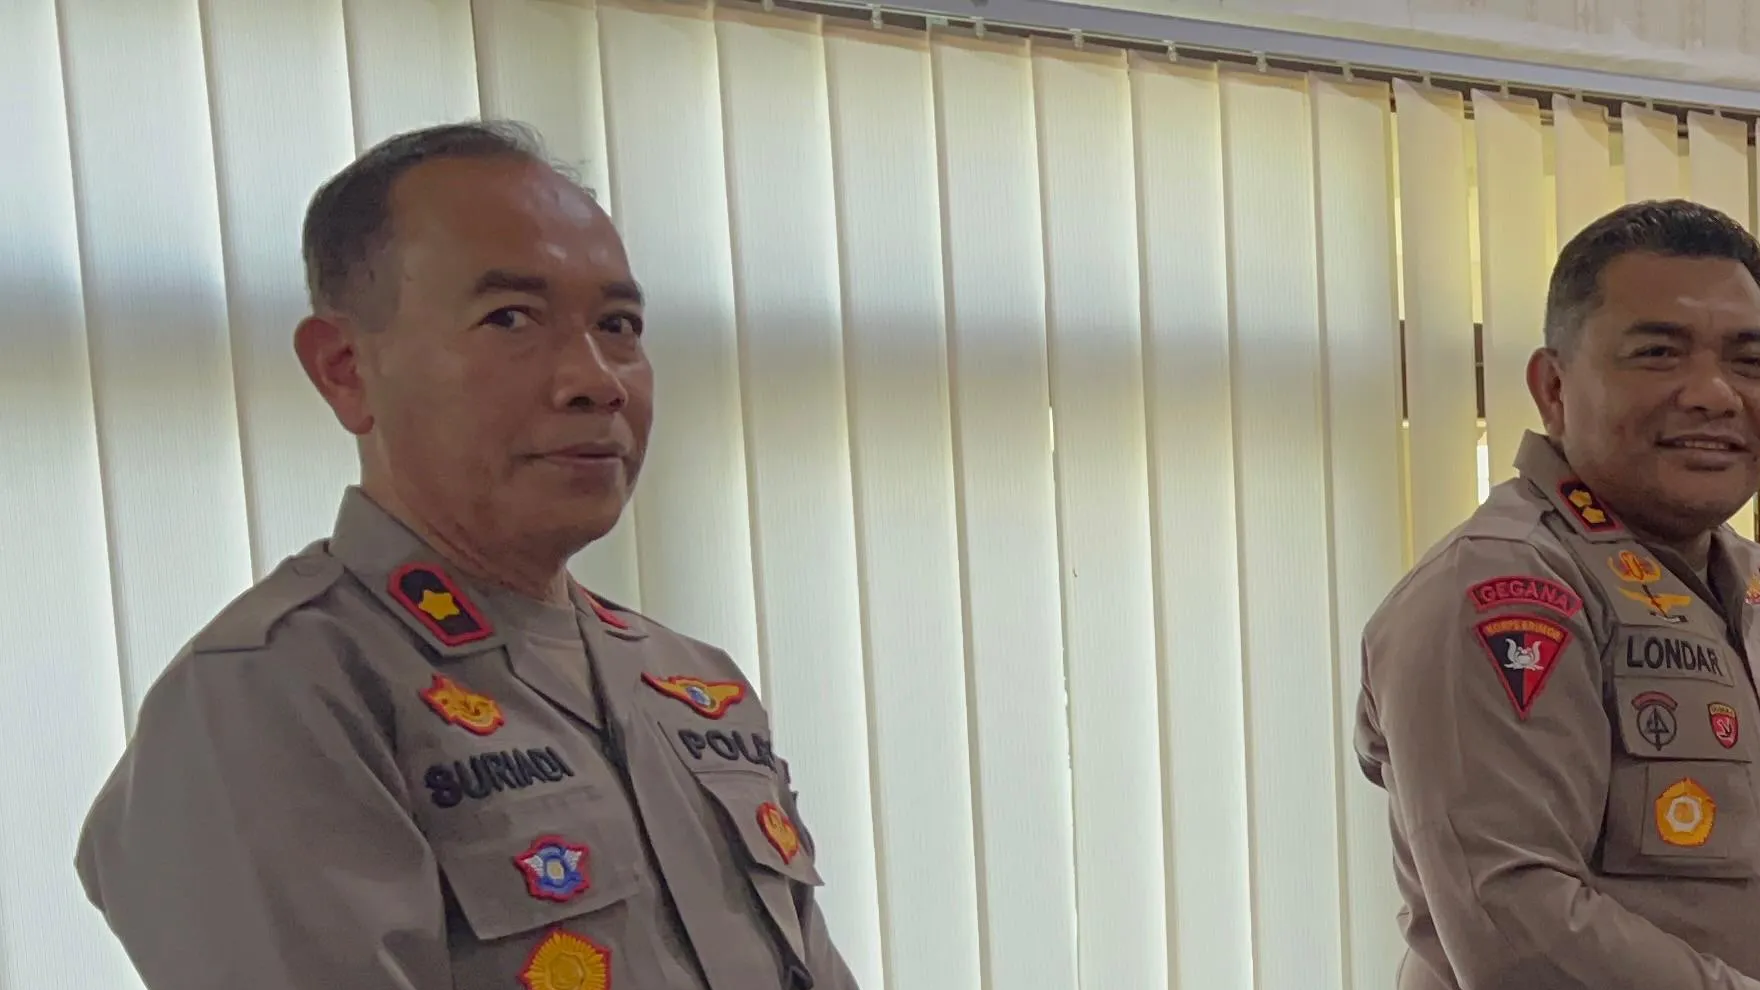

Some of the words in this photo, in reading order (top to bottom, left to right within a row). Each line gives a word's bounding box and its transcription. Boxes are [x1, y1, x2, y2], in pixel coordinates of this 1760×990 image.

[1481, 580, 1568, 611] GEGANA
[1626, 636, 1723, 677] LONDAR
[424, 746, 575, 809] SURIADI
